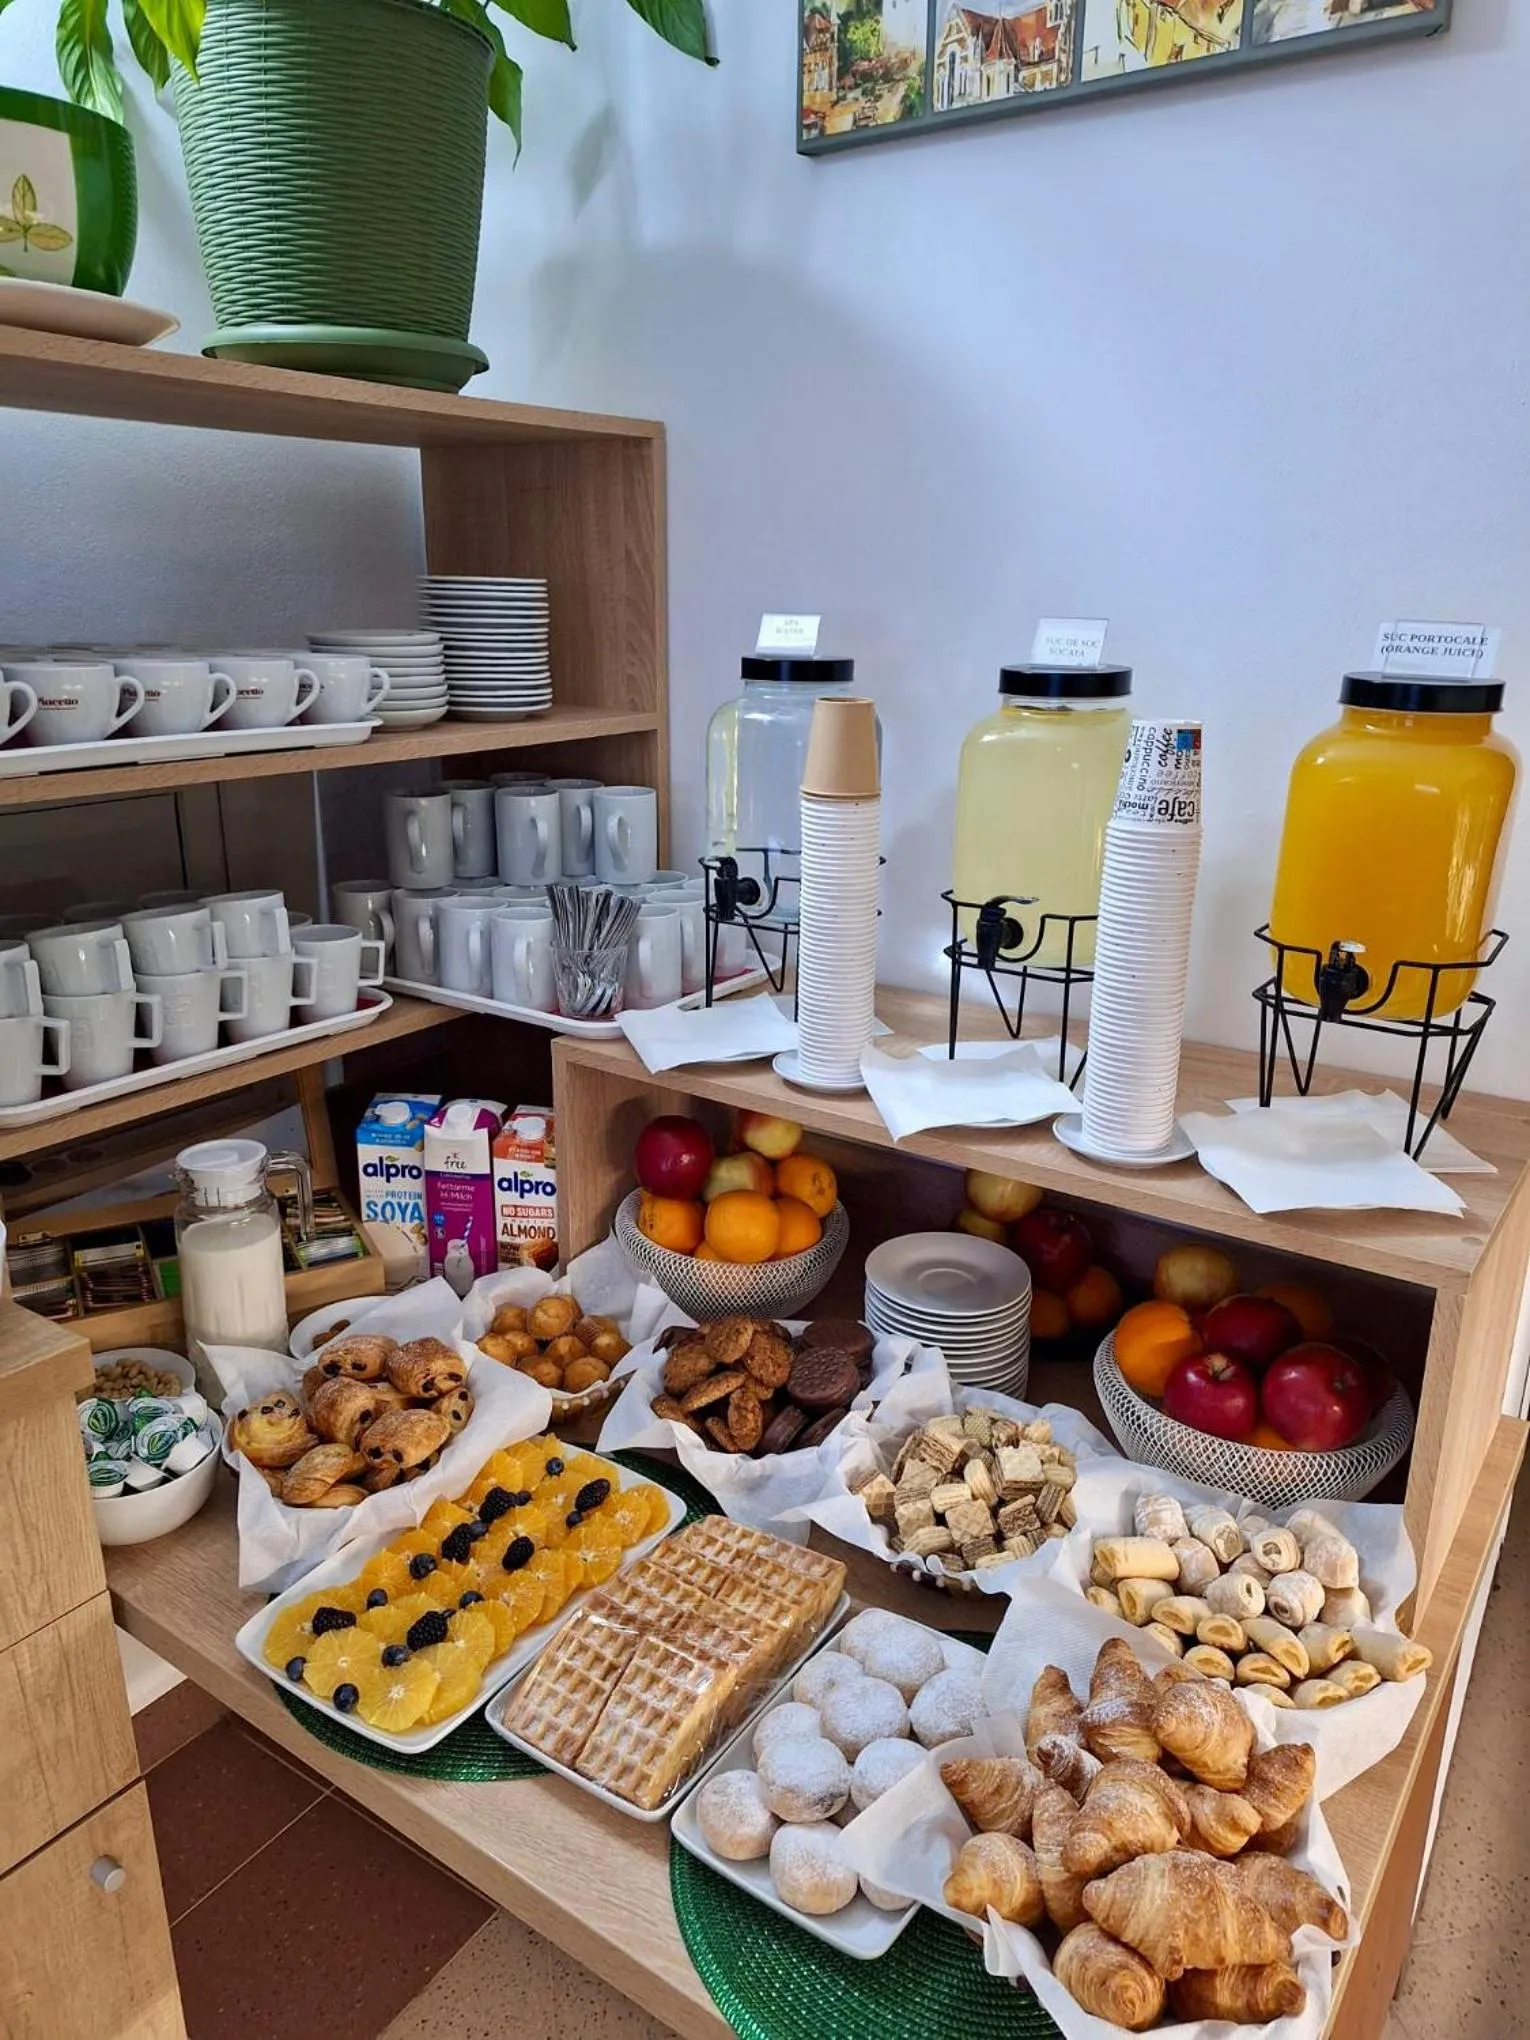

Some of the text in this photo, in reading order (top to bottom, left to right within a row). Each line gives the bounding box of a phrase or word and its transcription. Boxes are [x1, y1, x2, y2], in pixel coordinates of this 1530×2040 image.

[1383, 632, 1489, 646] SUC PORTOCALE
[1380, 644, 1439, 656] (ORANGE
[1136, 726, 1157, 792] cappuccino
[1157, 796, 1195, 822] cafe
[362, 1155, 423, 1183] alpro
[385, 1189, 423, 1201] PROTEIN
[497, 1171, 556, 1198] alpro
[365, 1198, 425, 1223] SOYA
[503, 1206, 515, 1217] NO
[517, 1207, 553, 1219] SUGARS
[502, 1222, 556, 1240] ALMOND
